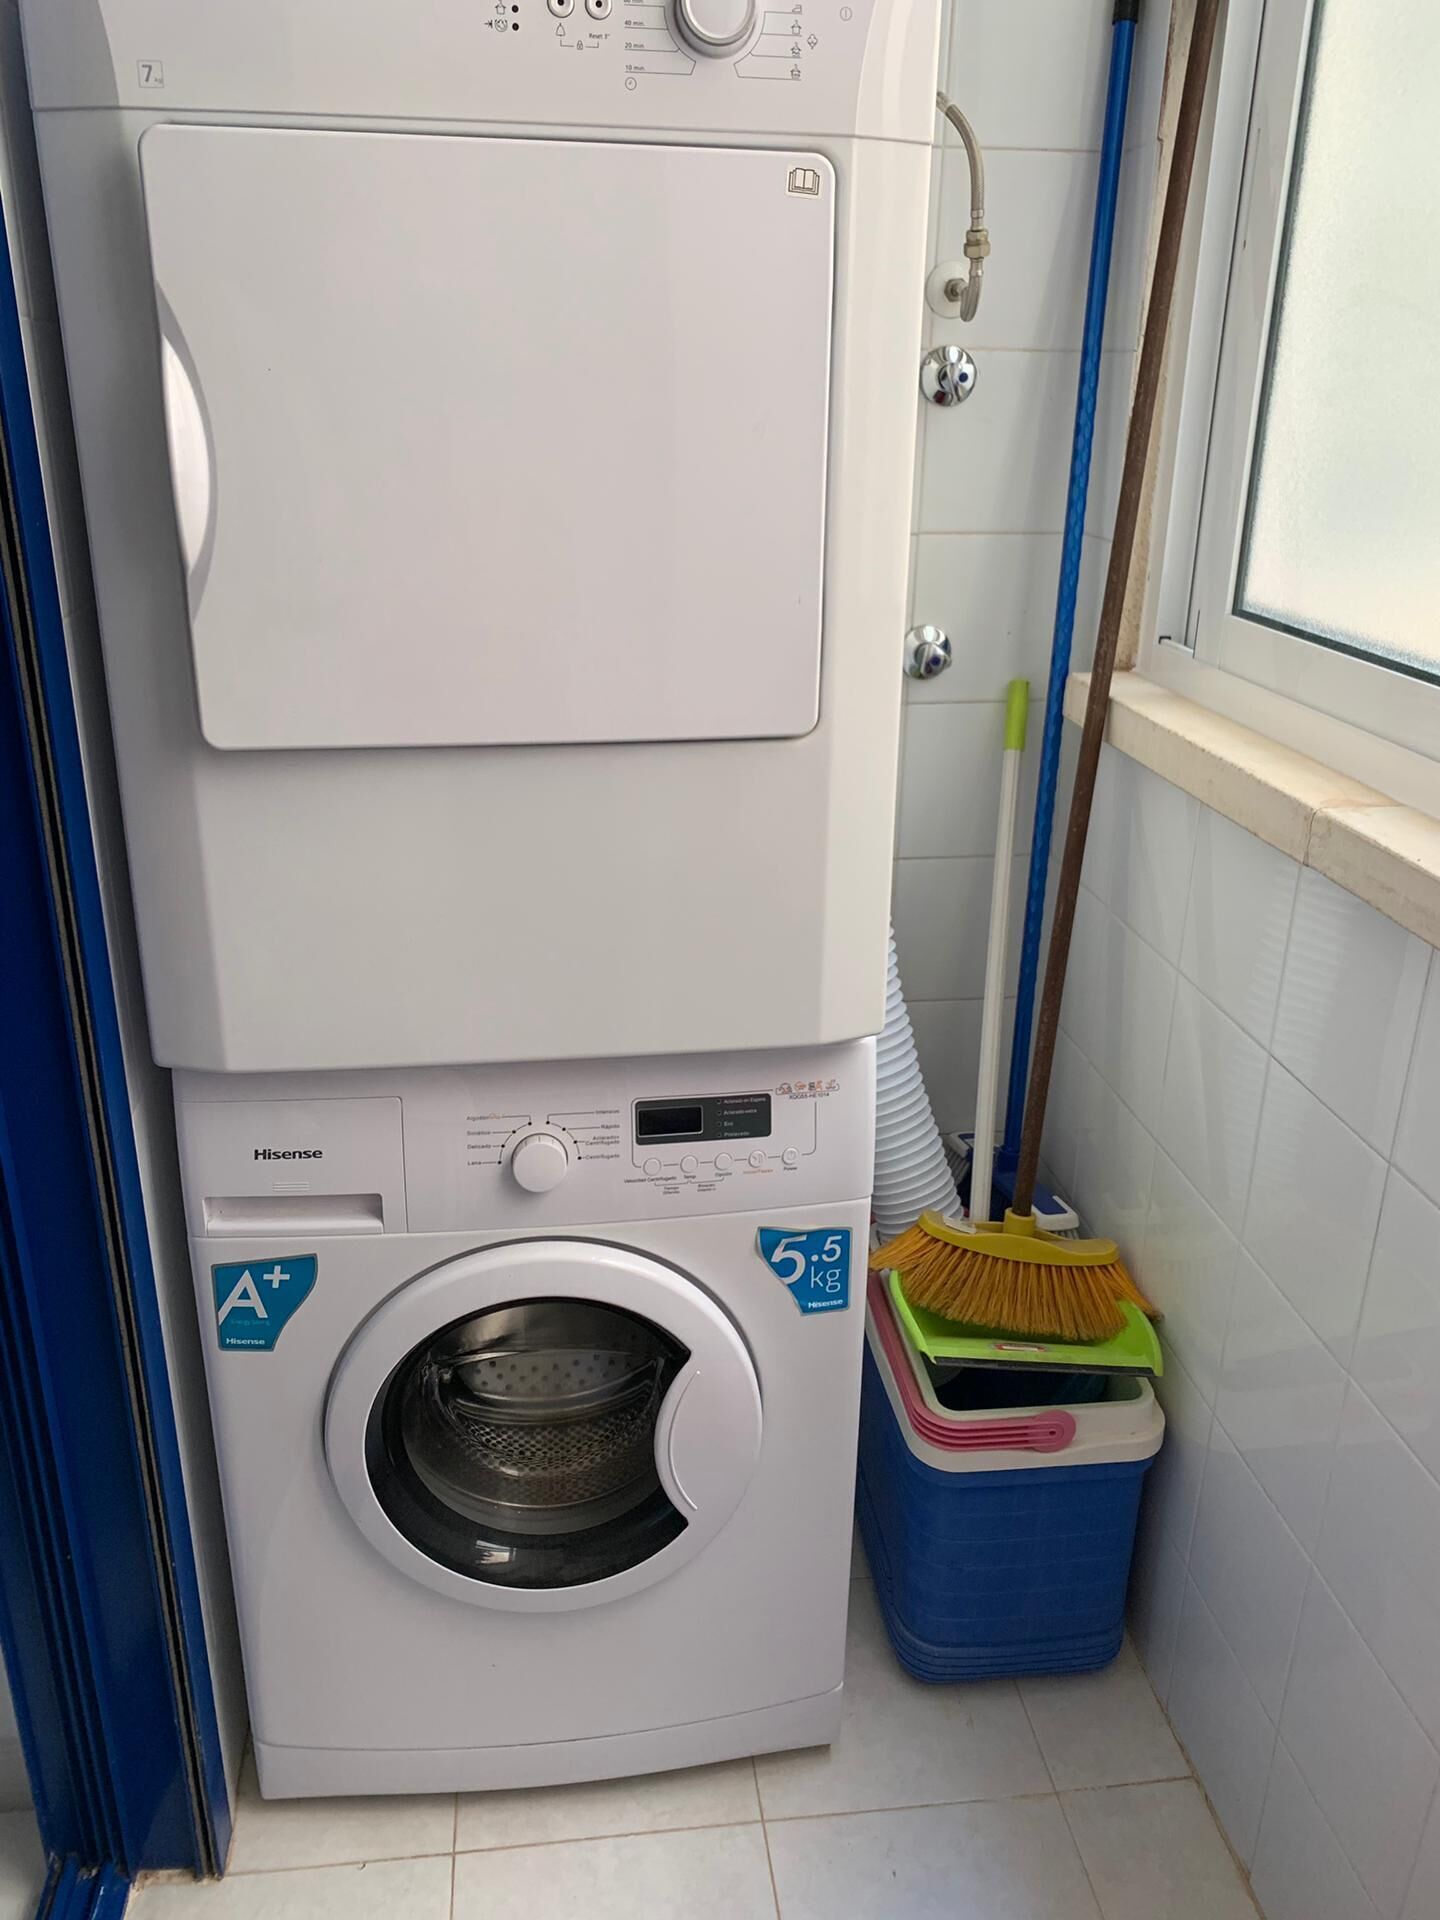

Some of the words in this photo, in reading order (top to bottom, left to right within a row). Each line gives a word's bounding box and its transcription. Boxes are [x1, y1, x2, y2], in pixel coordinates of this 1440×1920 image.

[142, 64, 152, 83] 7
[254, 1148, 323, 1160] Hisense
[810, 1265, 842, 1293] kg
[218, 1265, 291, 1326] A+
[808, 1299, 844, 1309] Hisense
[226, 1337, 265, 1345] Hisense
